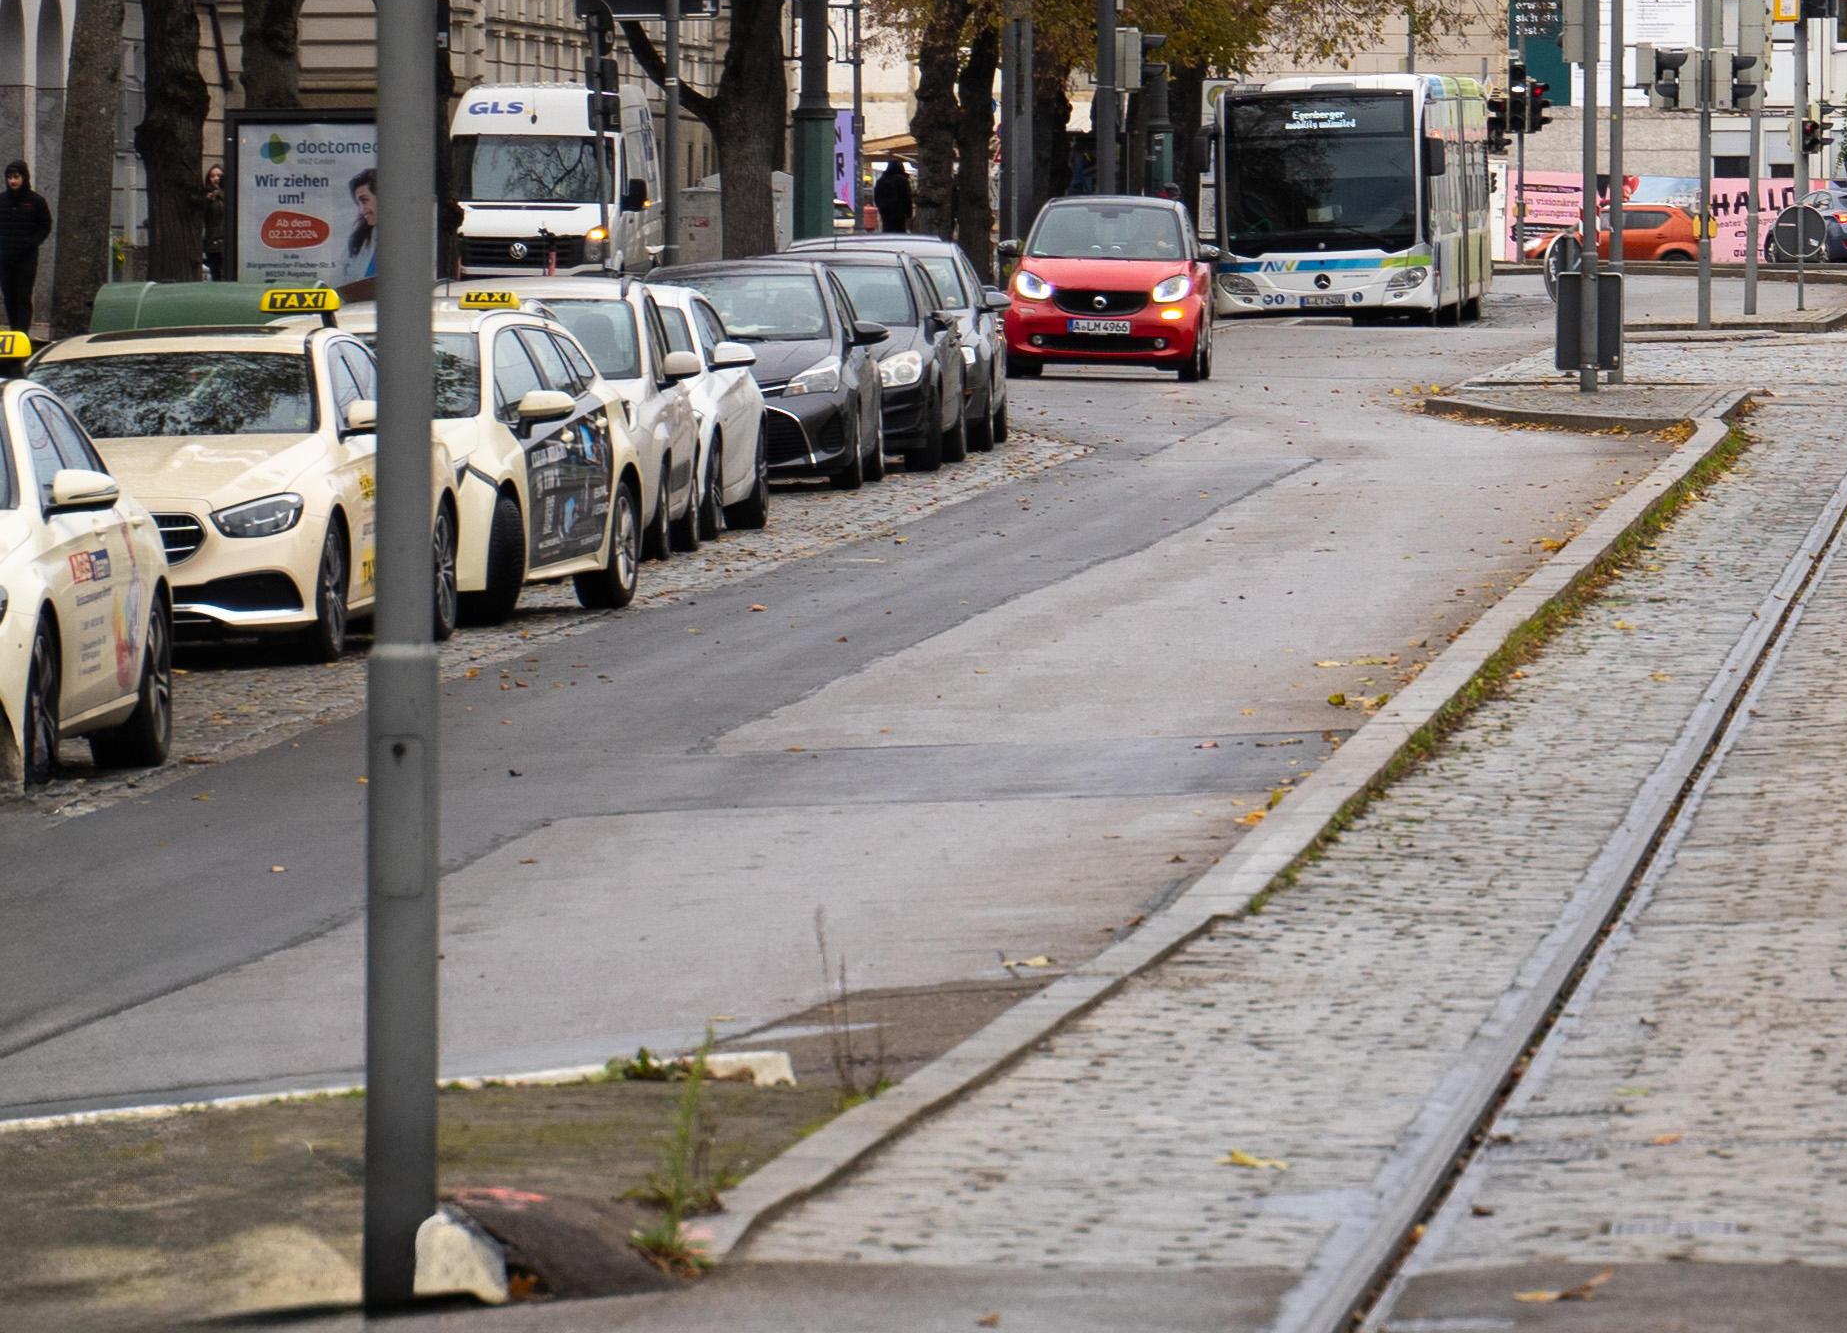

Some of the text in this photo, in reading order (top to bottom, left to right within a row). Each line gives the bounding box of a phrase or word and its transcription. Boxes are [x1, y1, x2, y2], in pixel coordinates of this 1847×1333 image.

[468, 102, 524, 115] GLS
[255, 174, 329, 187] Wir ziehen
[278, 191, 305, 204] um!
[275, 219, 311, 227] Ab dem
[268, 230, 318, 239] 02.12.2024
[272, 293, 325, 308] TAXI
[469, 292, 510, 302] TAXI
[1072, 322, 1128, 332] A LM 4966
